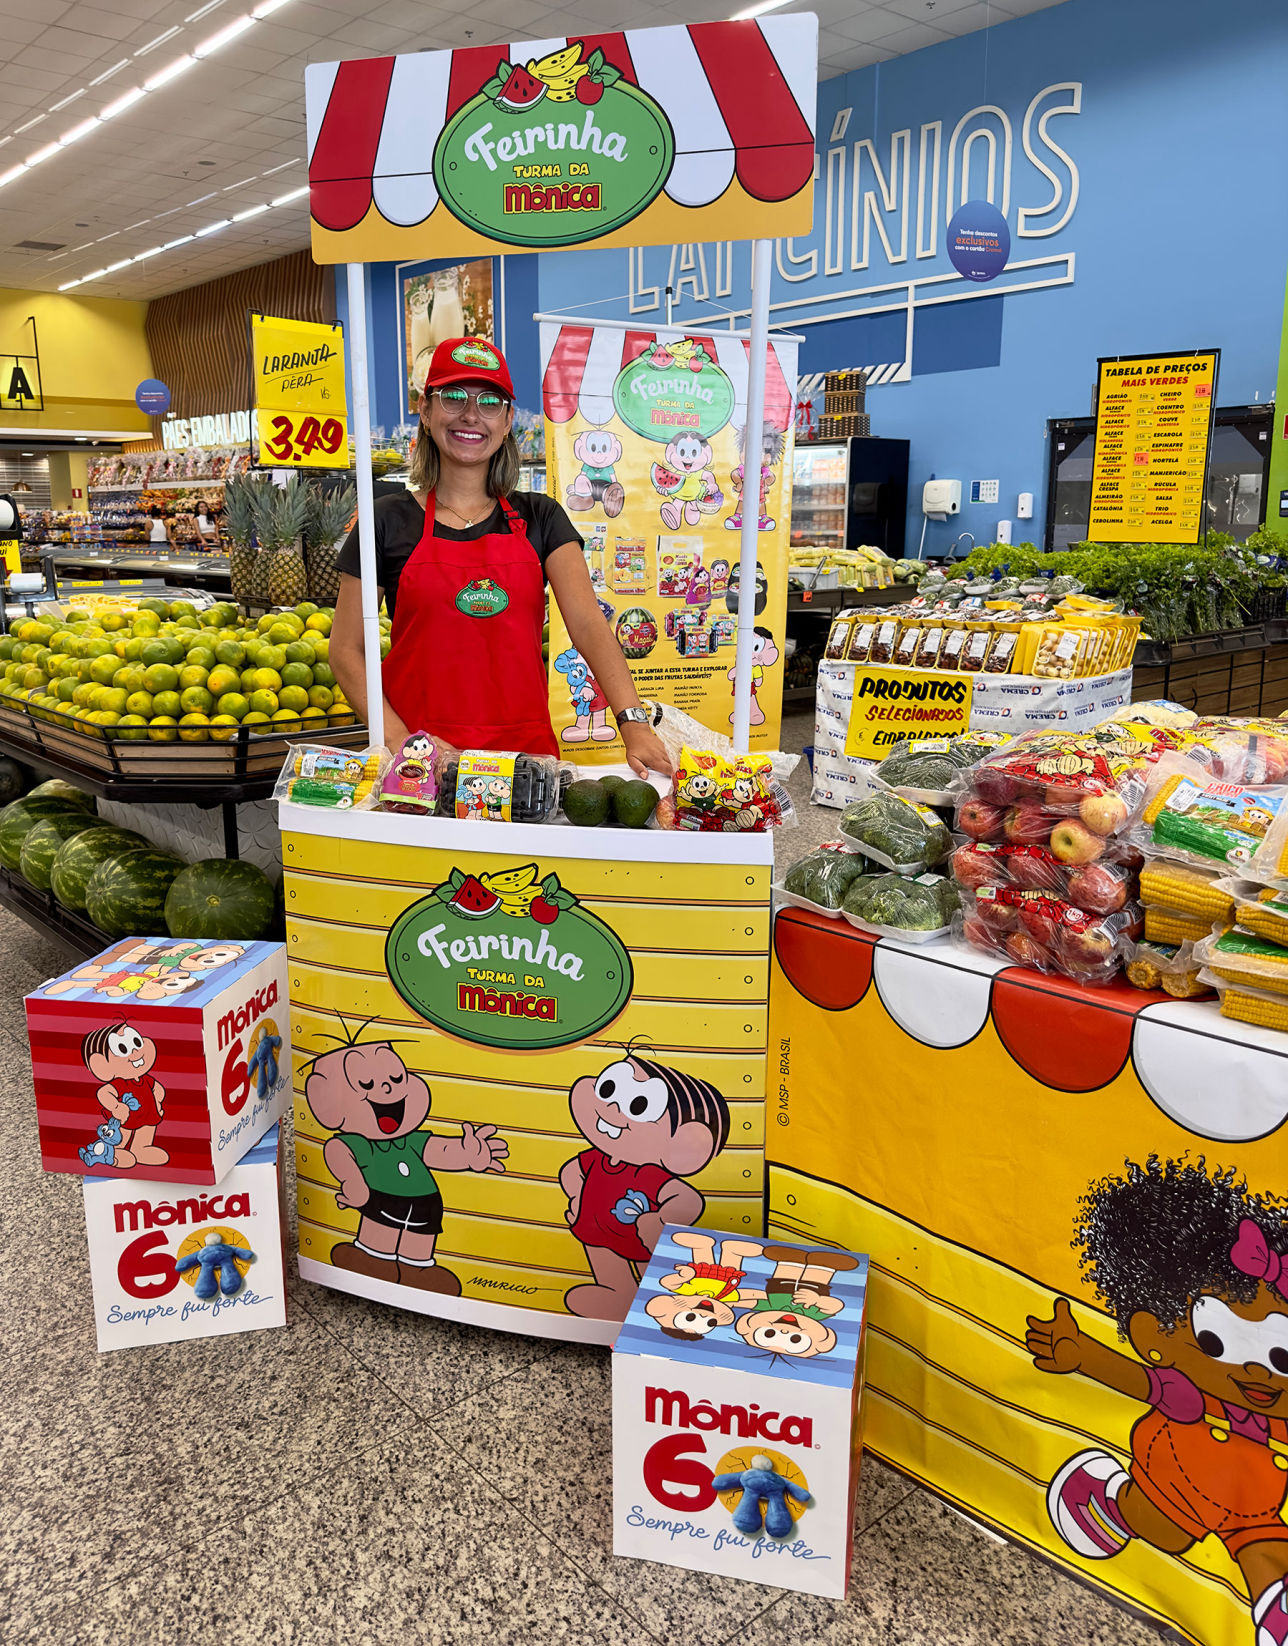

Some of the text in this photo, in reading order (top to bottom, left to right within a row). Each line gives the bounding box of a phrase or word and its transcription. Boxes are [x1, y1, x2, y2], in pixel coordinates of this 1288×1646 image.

[464, 110, 628, 171] Feirinha
[513, 163, 589, 178] TURMA DA
[956, 235, 999, 247] exclusivos
[263, 344, 337, 375] LARANJA
[1105, 362, 1208, 377] TABELA DE PREÇOS
[8, 367, 34, 399] A
[630, 373, 713, 405] Feirinha
[1121, 376, 1189, 388] MAIS VERDES
[656, 399, 680, 407] TURMA
[161, 412, 189, 450] PÃES
[462, 592, 499, 602] Feirinha
[858, 677, 967, 704] PRODUTOS
[1001, 687, 1029, 695] CREMA
[865, 705, 964, 721] SELECIONADOS
[826, 773, 848, 782] CREMA
[417, 923, 585, 981] Feirinha
[467, 967, 545, 988] TURMA DA
[780, 1037, 790, 1075] BRASIL
[779, 1084, 789, 1110] MSP
[218, 1114, 251, 1151] Sempre
[107, 1290, 273, 1326] Sempre fui forte
[626, 1505, 832, 1560] Sempre fui forte
